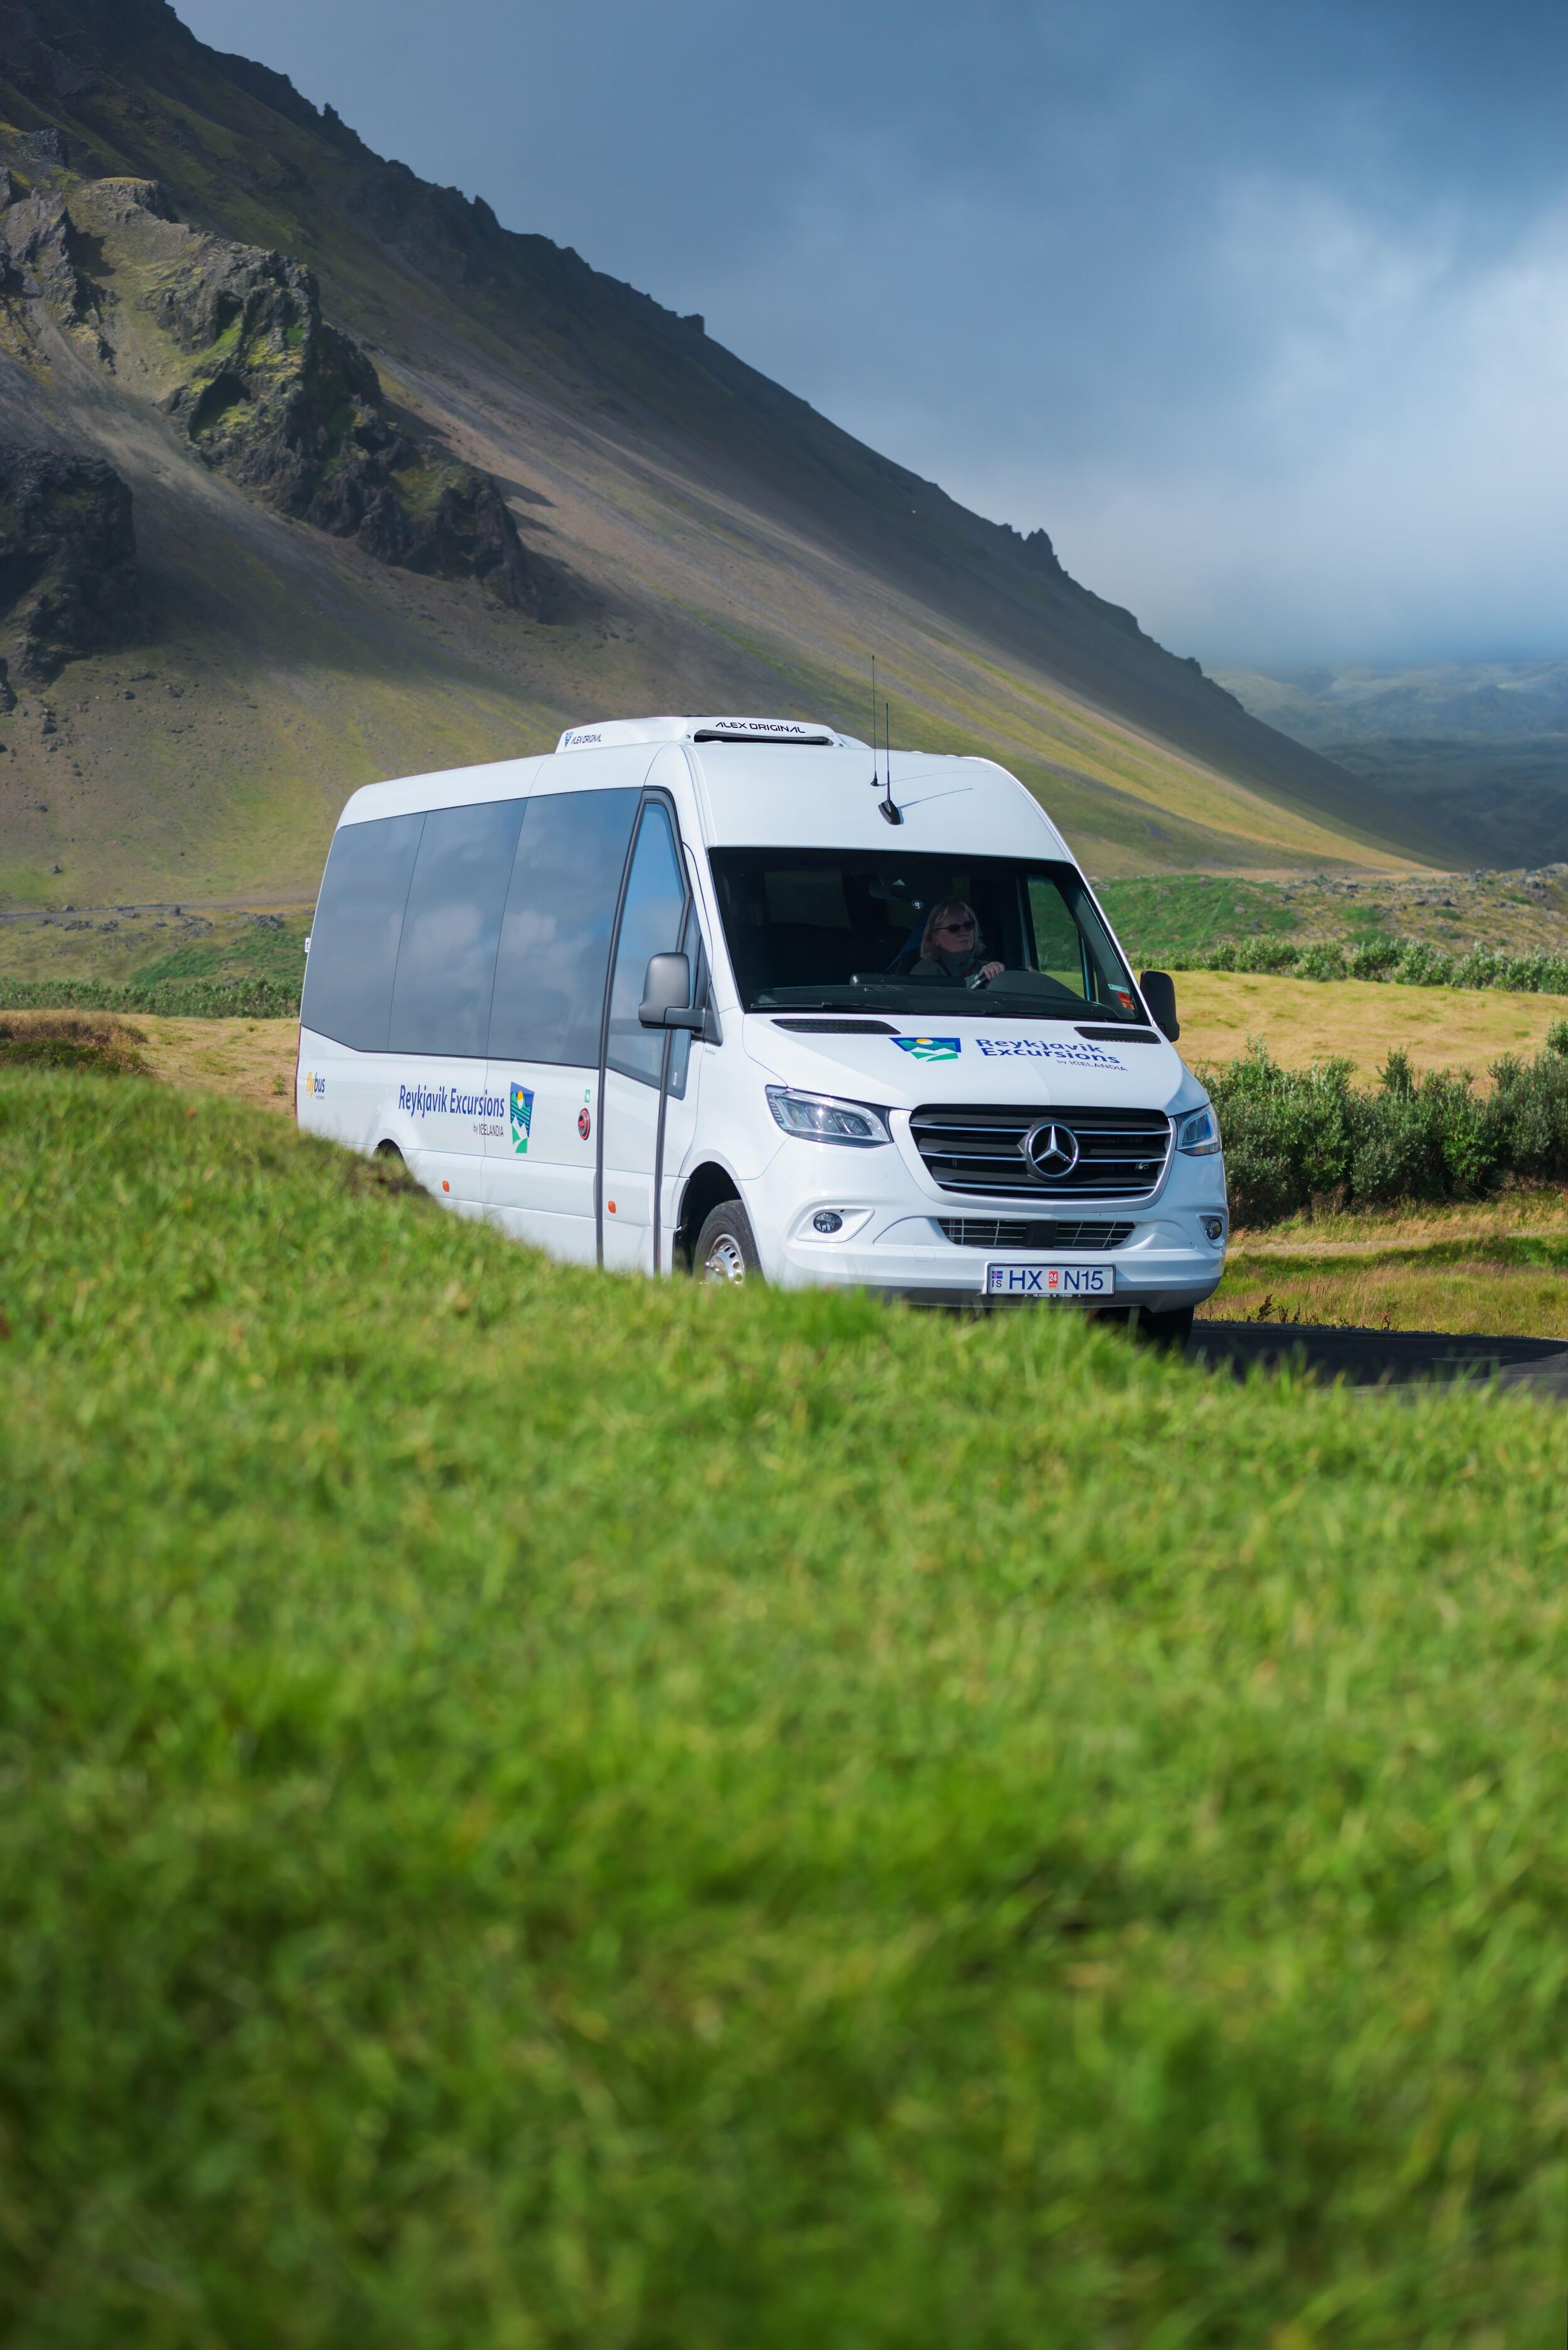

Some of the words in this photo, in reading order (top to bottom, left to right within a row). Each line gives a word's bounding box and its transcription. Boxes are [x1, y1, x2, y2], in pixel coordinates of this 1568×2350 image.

[749, 723, 806, 734] ORIGINAL
[570, 736, 583, 745] ALEX
[582, 734, 601, 743] ORIGINAL
[975, 1039, 1104, 1053] Reykjavik
[981, 1048, 1120, 1064] Excursions
[1069, 1060, 1128, 1072] ICELANDIA
[306, 1071, 325, 1098] flybus
[398, 1084, 448, 1118] Reykjavik
[450, 1088, 505, 1117] Excursions
[473, 1123, 478, 1135] by
[479, 1123, 504, 1137] ICELANDIA
[1009, 1270, 1043, 1290] HX
[1064, 1271, 1104, 1290] N15
